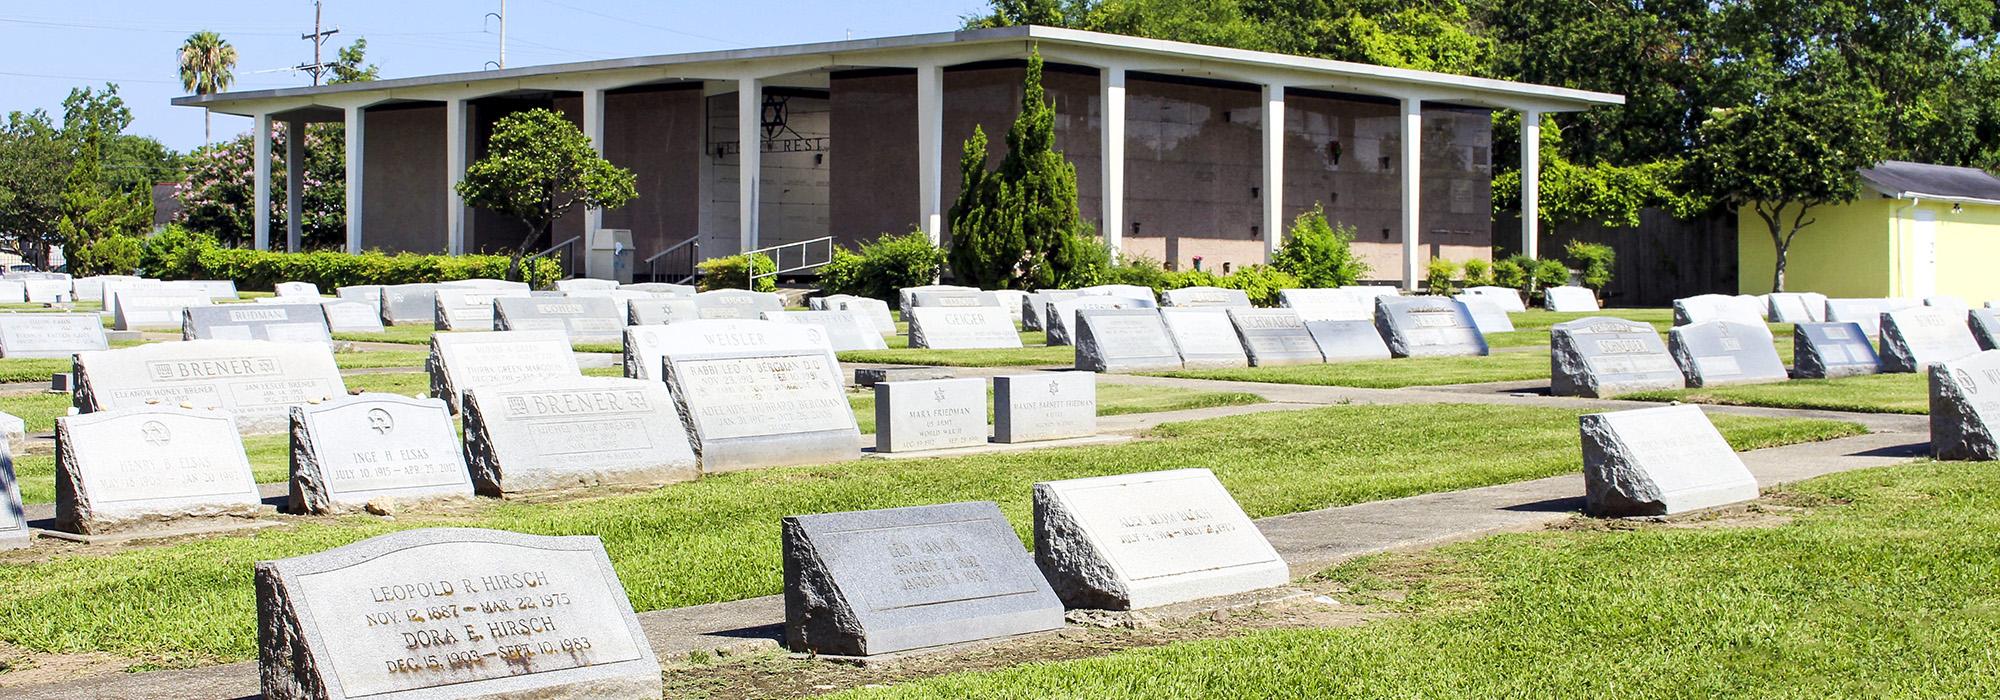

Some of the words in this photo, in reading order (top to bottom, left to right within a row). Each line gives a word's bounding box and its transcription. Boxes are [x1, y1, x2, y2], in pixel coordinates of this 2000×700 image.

[235, 309, 283, 320] RUDMAN
[944, 312, 987, 325] GEIGER
[703, 332, 767, 345] WEISLER
[178, 360, 257, 376] BRENER
[689, 364, 719, 376] RABBI
[114, 389, 151, 399] ELEANOR
[153, 387, 182, 397] HONEY
[184, 385, 214, 394] BRENER
[532, 392, 623, 414] BRENER
[933, 407, 971, 417] FRIEDMAN
[352, 451, 377, 465] INGE
[400, 449, 430, 461] ELSAS
[368, 580, 455, 603] LEOPOLD
[480, 570, 550, 592] HIRSCH
[364, 610, 402, 627] NOV.
[426, 604, 460, 621] 1887
[539, 593, 572, 608] 1975
[402, 627, 459, 649] DORA
[463, 624, 484, 642] E.
[486, 616, 556, 640] HIRSCH
[445, 649, 481, 669] 1903
[559, 636, 593, 654] 1983
